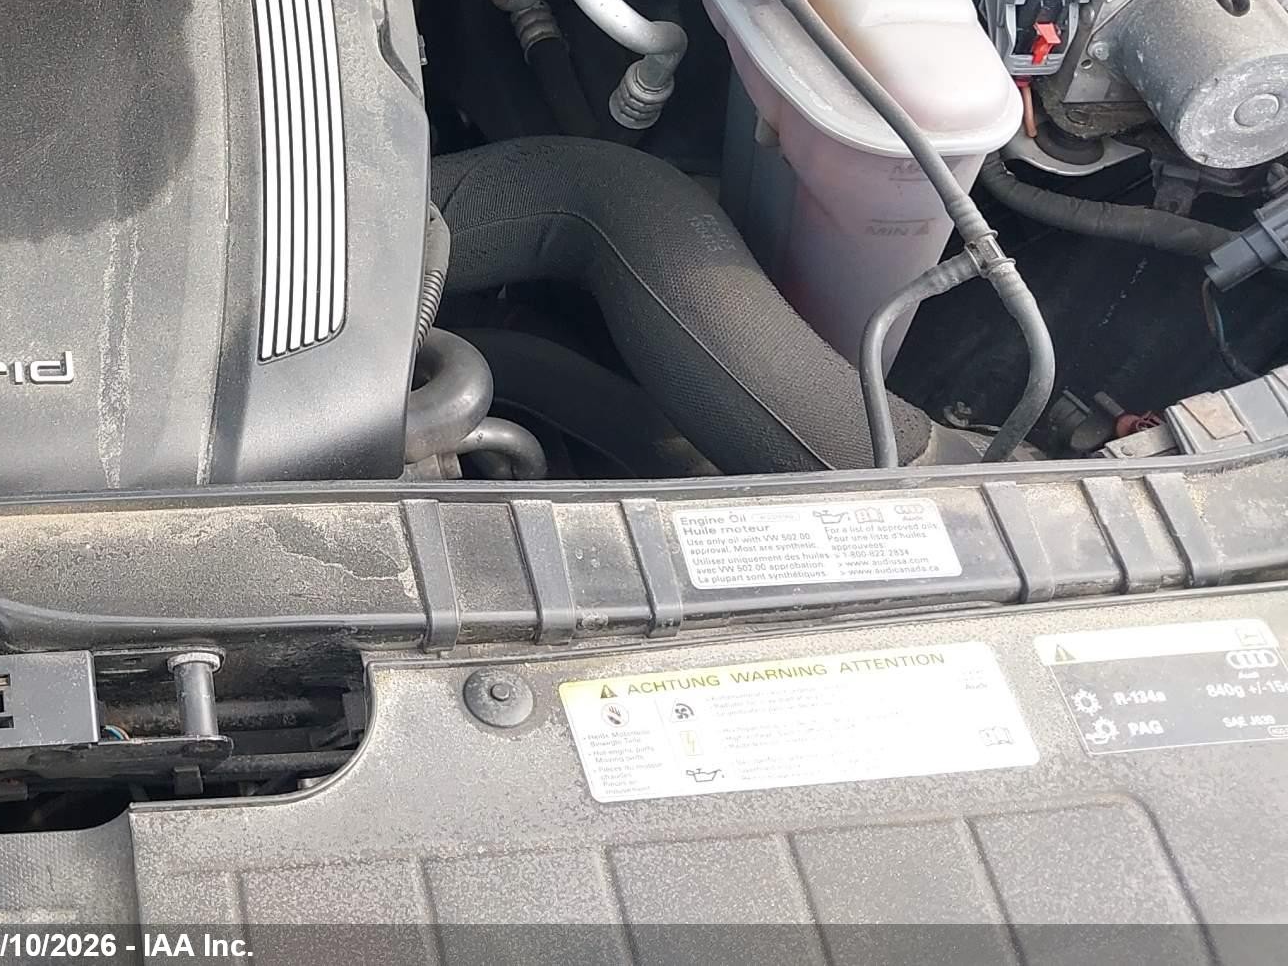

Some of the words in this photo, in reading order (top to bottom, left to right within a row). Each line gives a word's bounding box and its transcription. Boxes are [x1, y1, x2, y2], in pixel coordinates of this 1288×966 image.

[680, 517, 725, 527] Engine
[729, 514, 746, 523] Oil
[683, 526, 717, 536] Huile
[721, 525, 770, 534] moteur
[877, 523, 919, 534] approved
[706, 537, 726, 546] only
[741, 535, 761, 543] with
[734, 544, 757, 552] Most
[692, 557, 726, 566] Utilisez
[728, 554, 782, 565] uniquement
[784, 553, 800, 561] des
[802, 551, 830, 560] huiles
[696, 567, 717, 575] avec
[719, 565, 735, 573] VW
[769, 561, 824, 572] approbation
[712, 574, 743, 585] plupart
[746, 573, 766, 581] sont
[627, 674, 721, 695] ACHTUNG
[729, 663, 828, 684] WARNING
[839, 653, 945, 674] ATTENTION
[1206, 683, 1246, 698] 840g
[1113, 689, 1167, 706] R-134a
[1127, 720, 1164, 735] PAG
[1222, 716, 1247, 728] SAE
